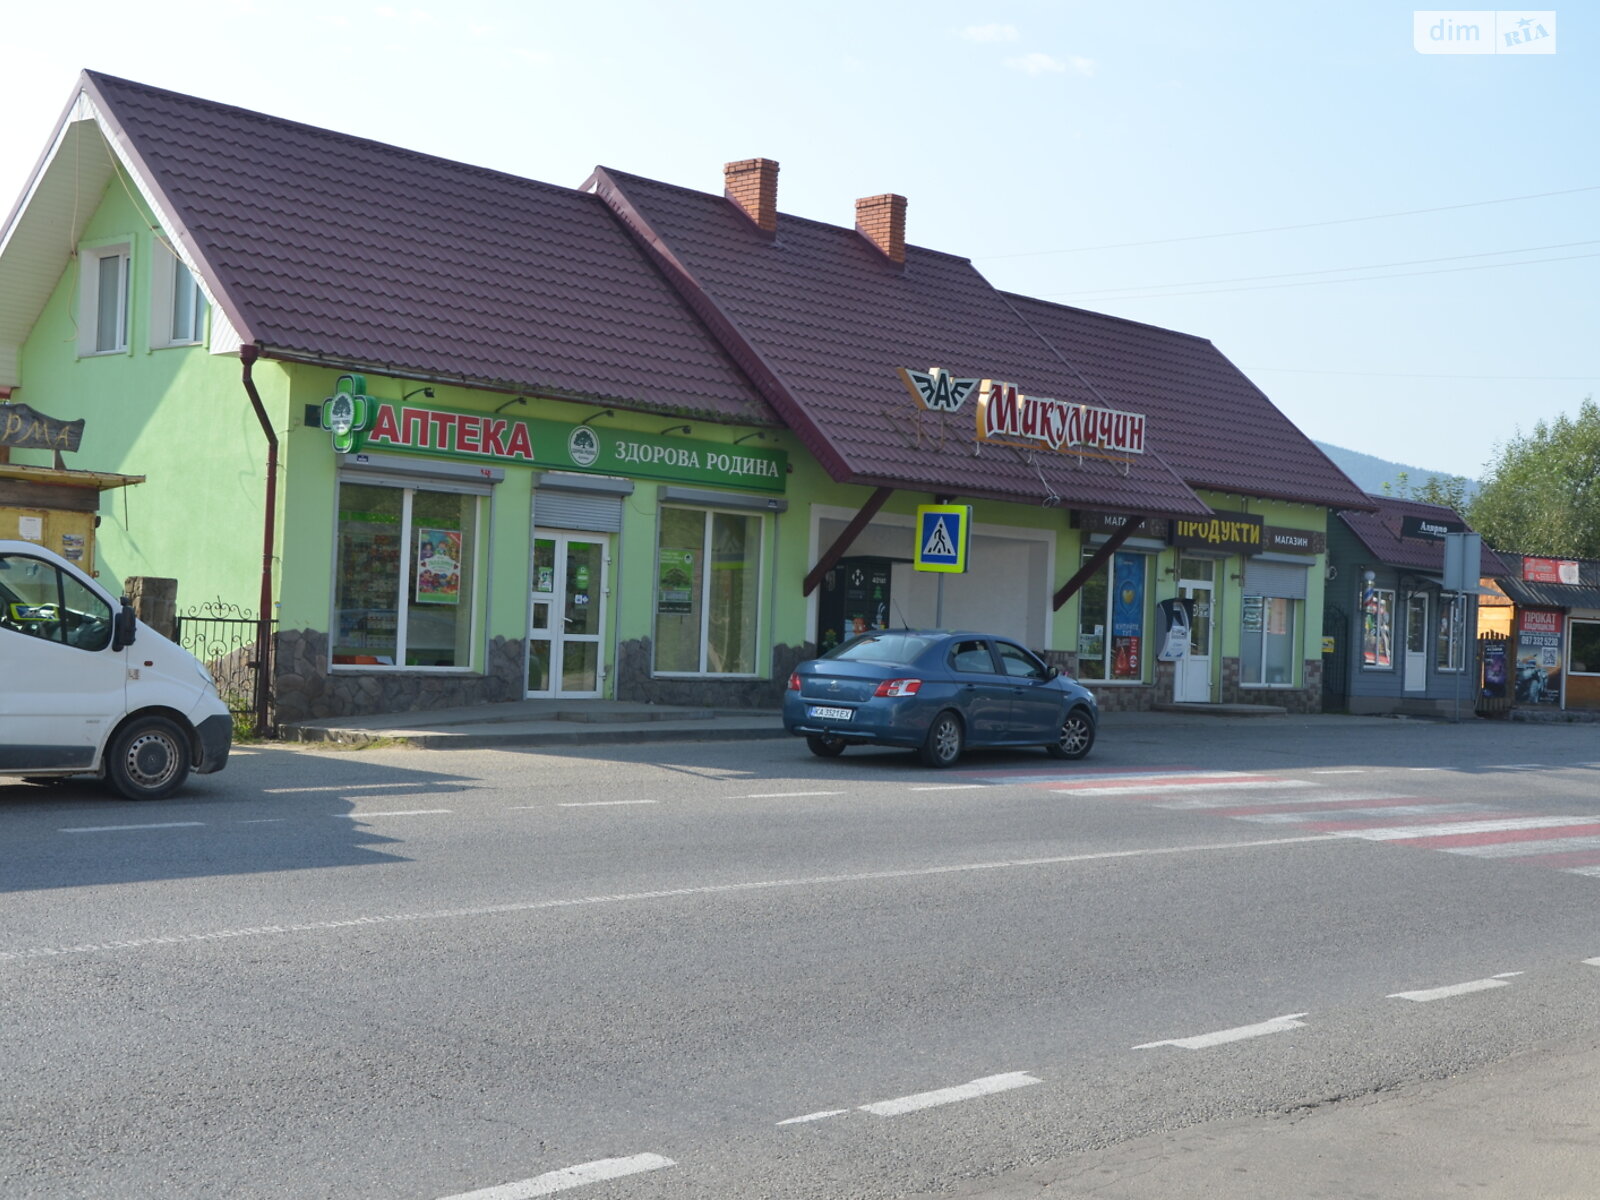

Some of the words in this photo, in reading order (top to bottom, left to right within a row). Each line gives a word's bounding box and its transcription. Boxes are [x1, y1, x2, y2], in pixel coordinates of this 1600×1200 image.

[368, 403, 535, 461] АПТЕКА
[986, 383, 1144, 451] Микуличин
[614, 440, 701, 471] ЗДОРОВА
[705, 450, 781, 479] РОДИНА
[1177, 519, 1261, 545] ПРОДУКТИ
[1274, 534, 1309, 548] МАГАЗИН
[1524, 610, 1557, 625] ПРОКАТ
